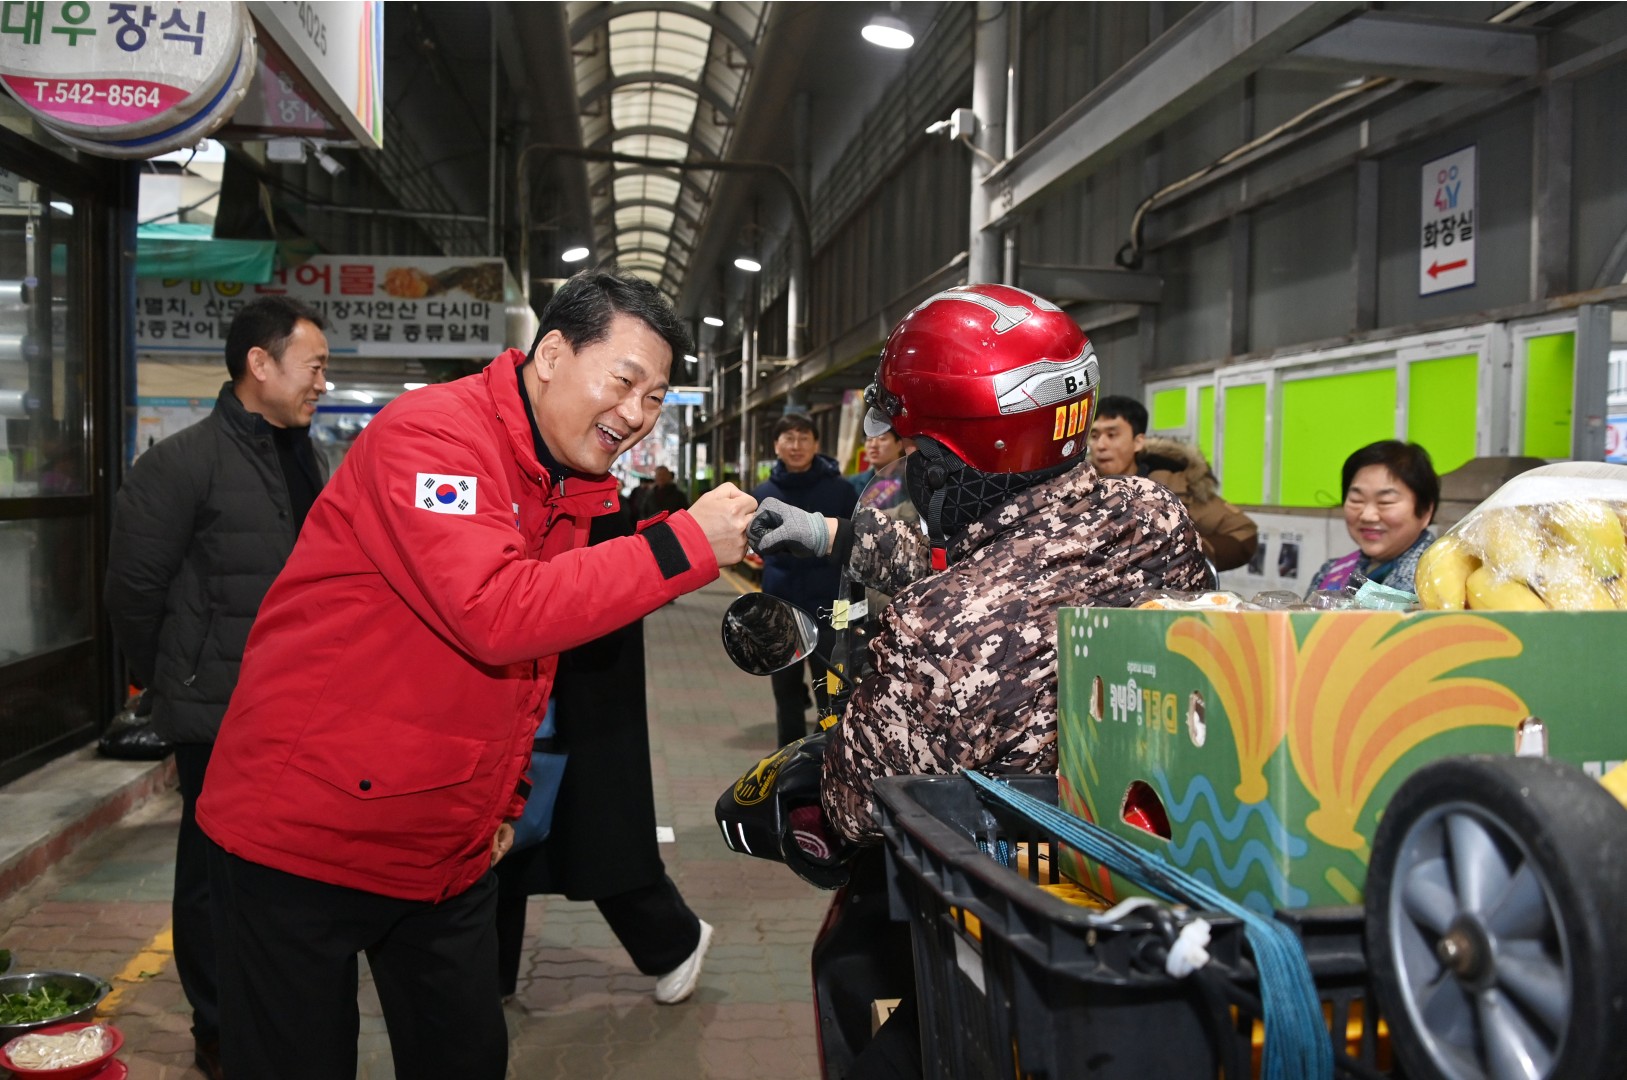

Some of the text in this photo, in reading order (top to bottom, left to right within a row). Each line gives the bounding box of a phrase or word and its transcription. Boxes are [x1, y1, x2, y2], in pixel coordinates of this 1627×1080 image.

[34, 81, 160, 108] T.542-8564
[1423, 209, 1473, 249] 화장실
[427, 301, 490, 320] 다시마
[403, 323, 489, 343] 종류일체
[1065, 370, 1090, 394] B-1
